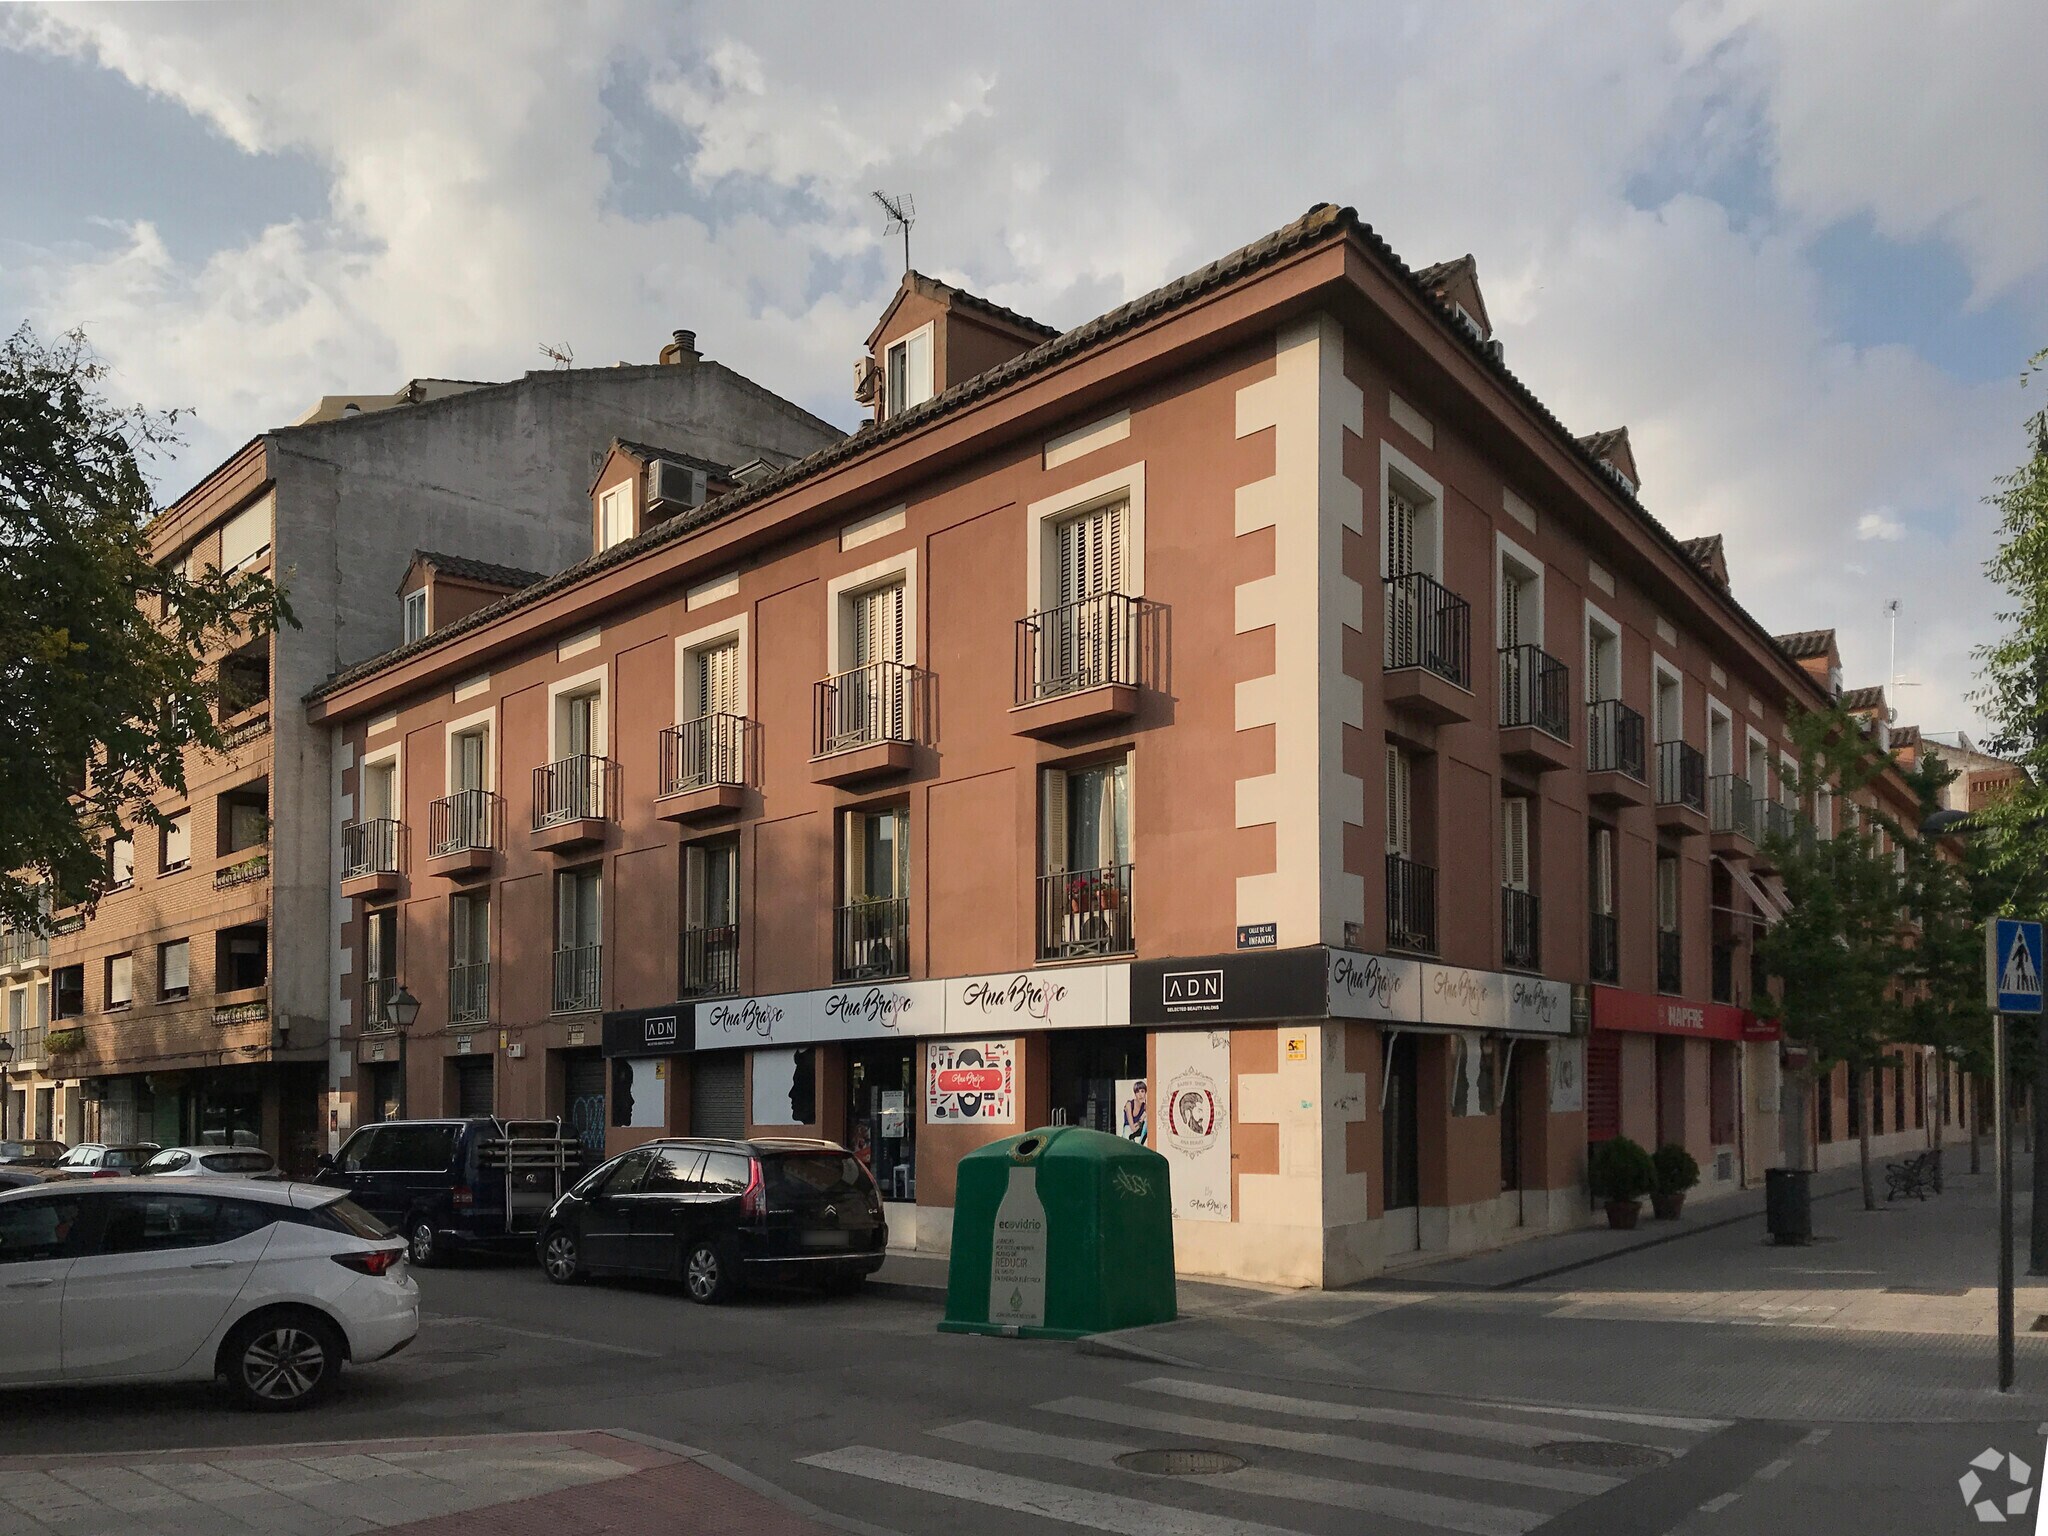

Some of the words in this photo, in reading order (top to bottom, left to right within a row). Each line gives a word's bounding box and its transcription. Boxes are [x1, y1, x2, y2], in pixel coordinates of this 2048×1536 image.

[1248, 926, 1260, 934] CALLE
[1248, 934, 1275, 946] INFANTAS
[1169, 977, 1217, 998] ADN
[1333, 957, 1363, 997] Ana
[963, 981, 1006, 1014] Ana
[709, 1004, 742, 1033] Ana
[824, 993, 863, 1024] Ana
[1668, 1006, 1704, 1029] MAPFRE
[648, 1021, 674, 1036] ADN
[998, 1218, 1042, 1230] ecovidrio
[995, 1257, 1028, 1268] REDUCIR
